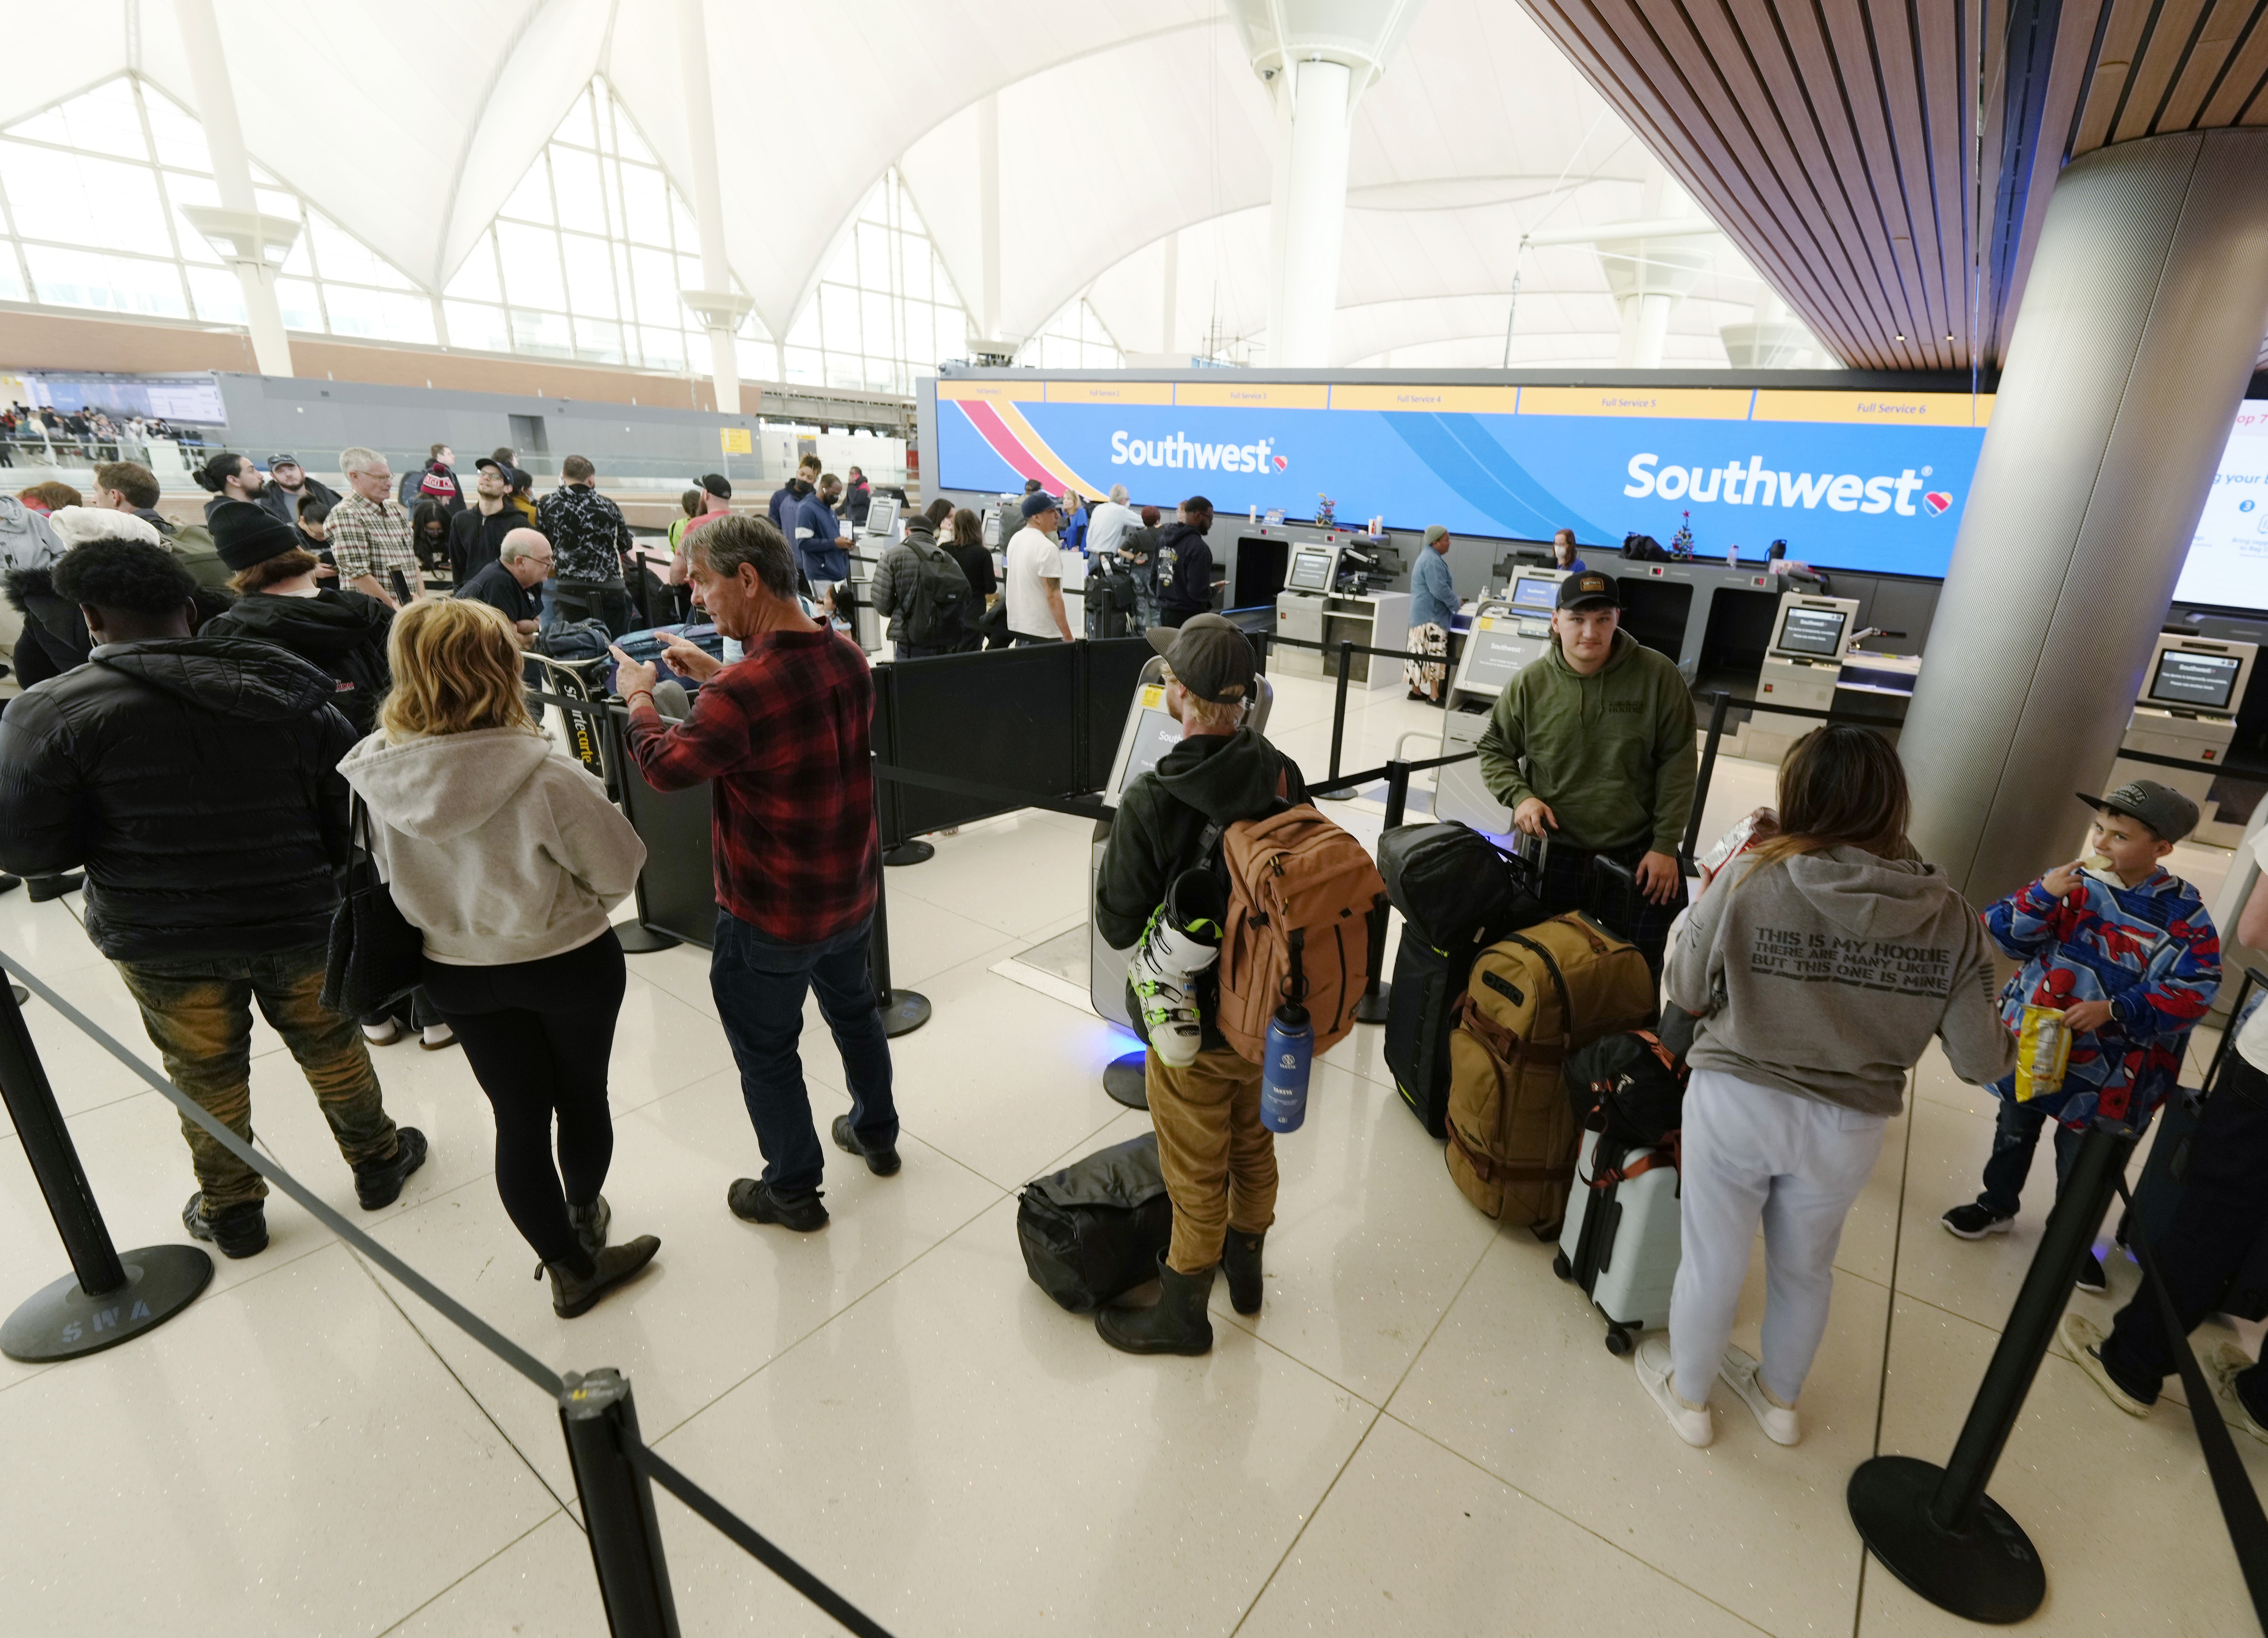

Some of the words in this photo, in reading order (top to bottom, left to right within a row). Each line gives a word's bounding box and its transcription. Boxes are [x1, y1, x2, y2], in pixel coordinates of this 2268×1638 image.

[1602, 398, 1617, 406] Full
[1619, 398, 1649, 407] Service
[1651, 399, 1656, 407] 5
[1857, 403, 1876, 412] Full
[1879, 403, 1916, 414] Service
[1919, 405, 1926, 414] 6
[1111, 430, 1270, 474] Southwest
[1623, 452, 1923, 517] Southwest
[2226, 474, 2261, 485] your
[1158, 730, 1183, 744] South
[1755, 941, 1803, 959] THERE
[1809, 948, 1838, 961] ARE
[1843, 954, 1891, 968] MANY
[1898, 961, 1932, 974] LIKE
[1933, 963, 1949, 976] IT
[1756, 927, 1801, 945] THIS
[1809, 934, 1825, 947] IS
[1833, 937, 1868, 953] MY
[1875, 943, 1950, 964] HOODIE
[1752, 953, 1787, 969] BUT
[1795, 959, 1831, 973] THIS
[1837, 965, 1874, 980] ONE
[1881, 972, 1898, 983] IS
[1904, 975, 1949, 990] MINE
